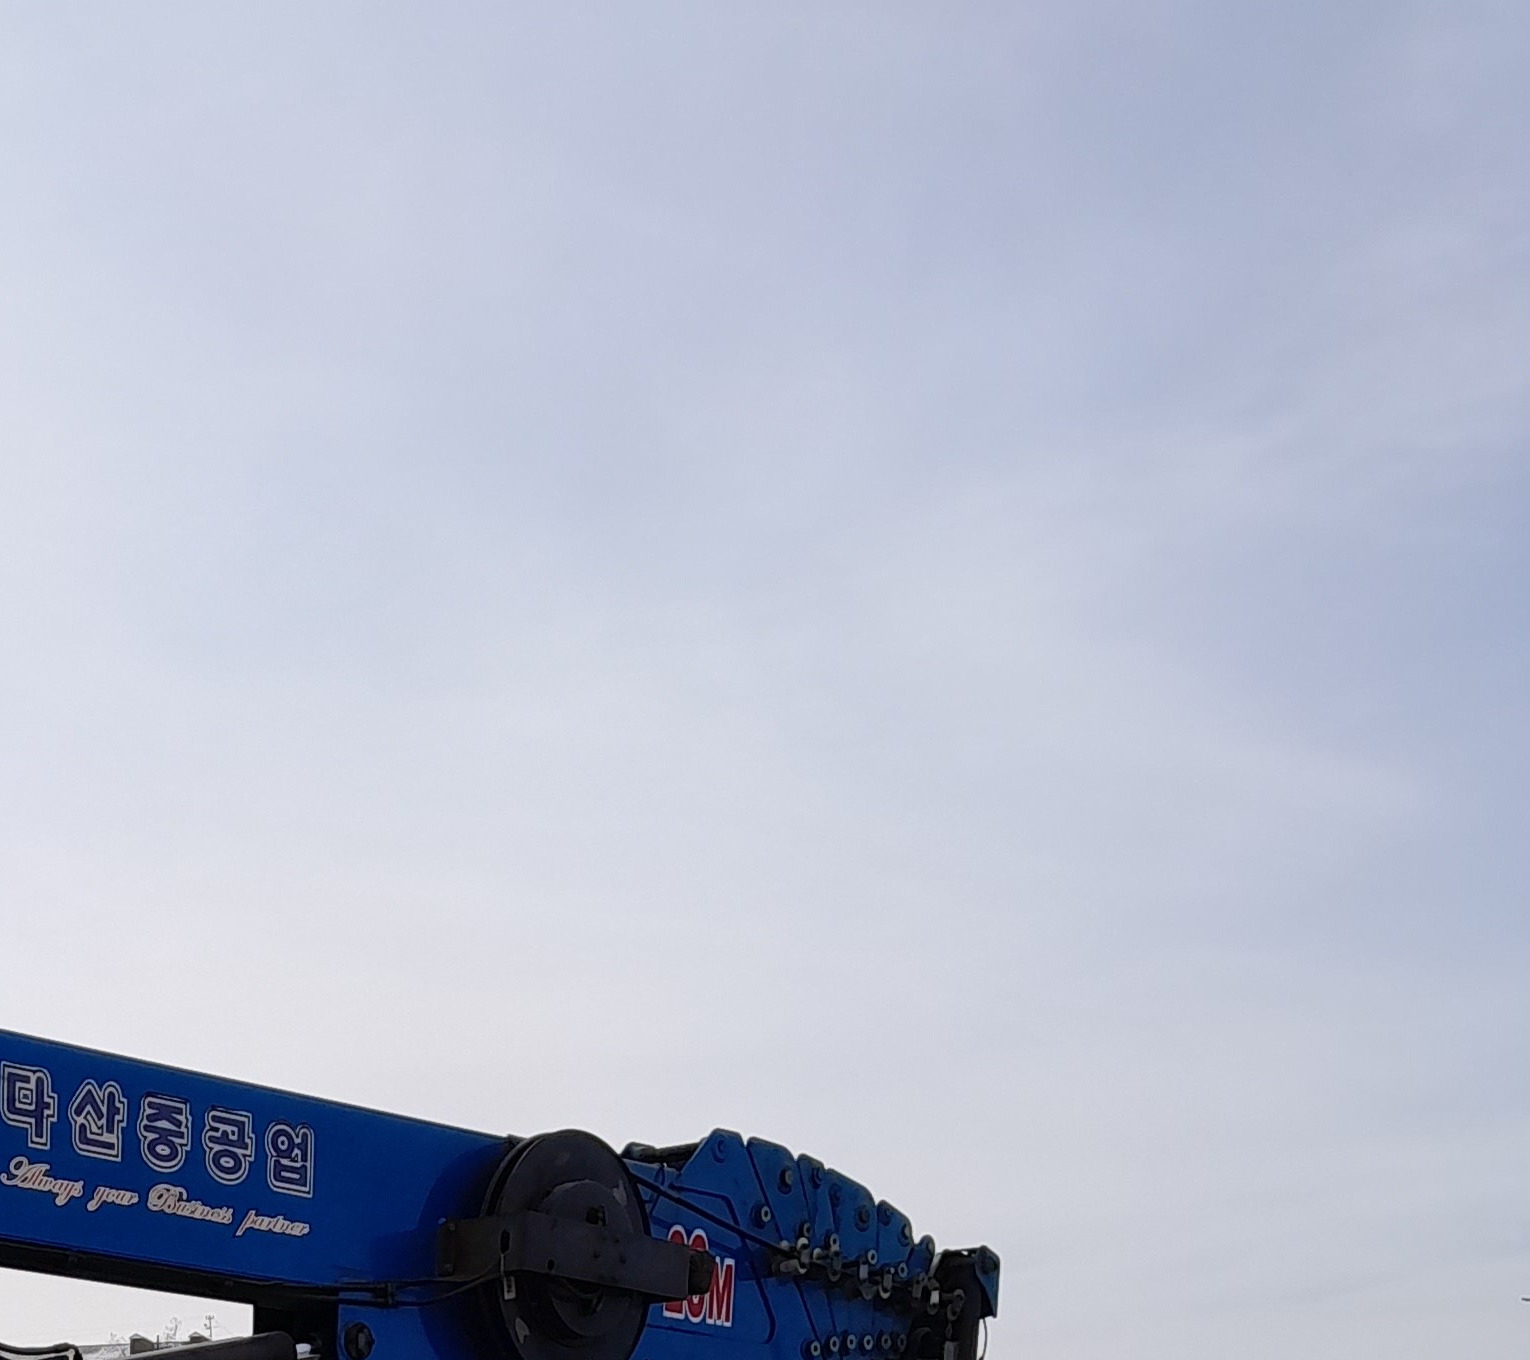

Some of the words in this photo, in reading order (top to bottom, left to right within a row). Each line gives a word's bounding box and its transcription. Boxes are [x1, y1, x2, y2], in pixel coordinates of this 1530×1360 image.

[0, 1061, 315, 1199] 다산중공업
[0, 1156, 84, 1206] Always
[87, 1183, 139, 1211] your
[147, 1183, 233, 1225] Business
[235, 1209, 312, 1238] partner
